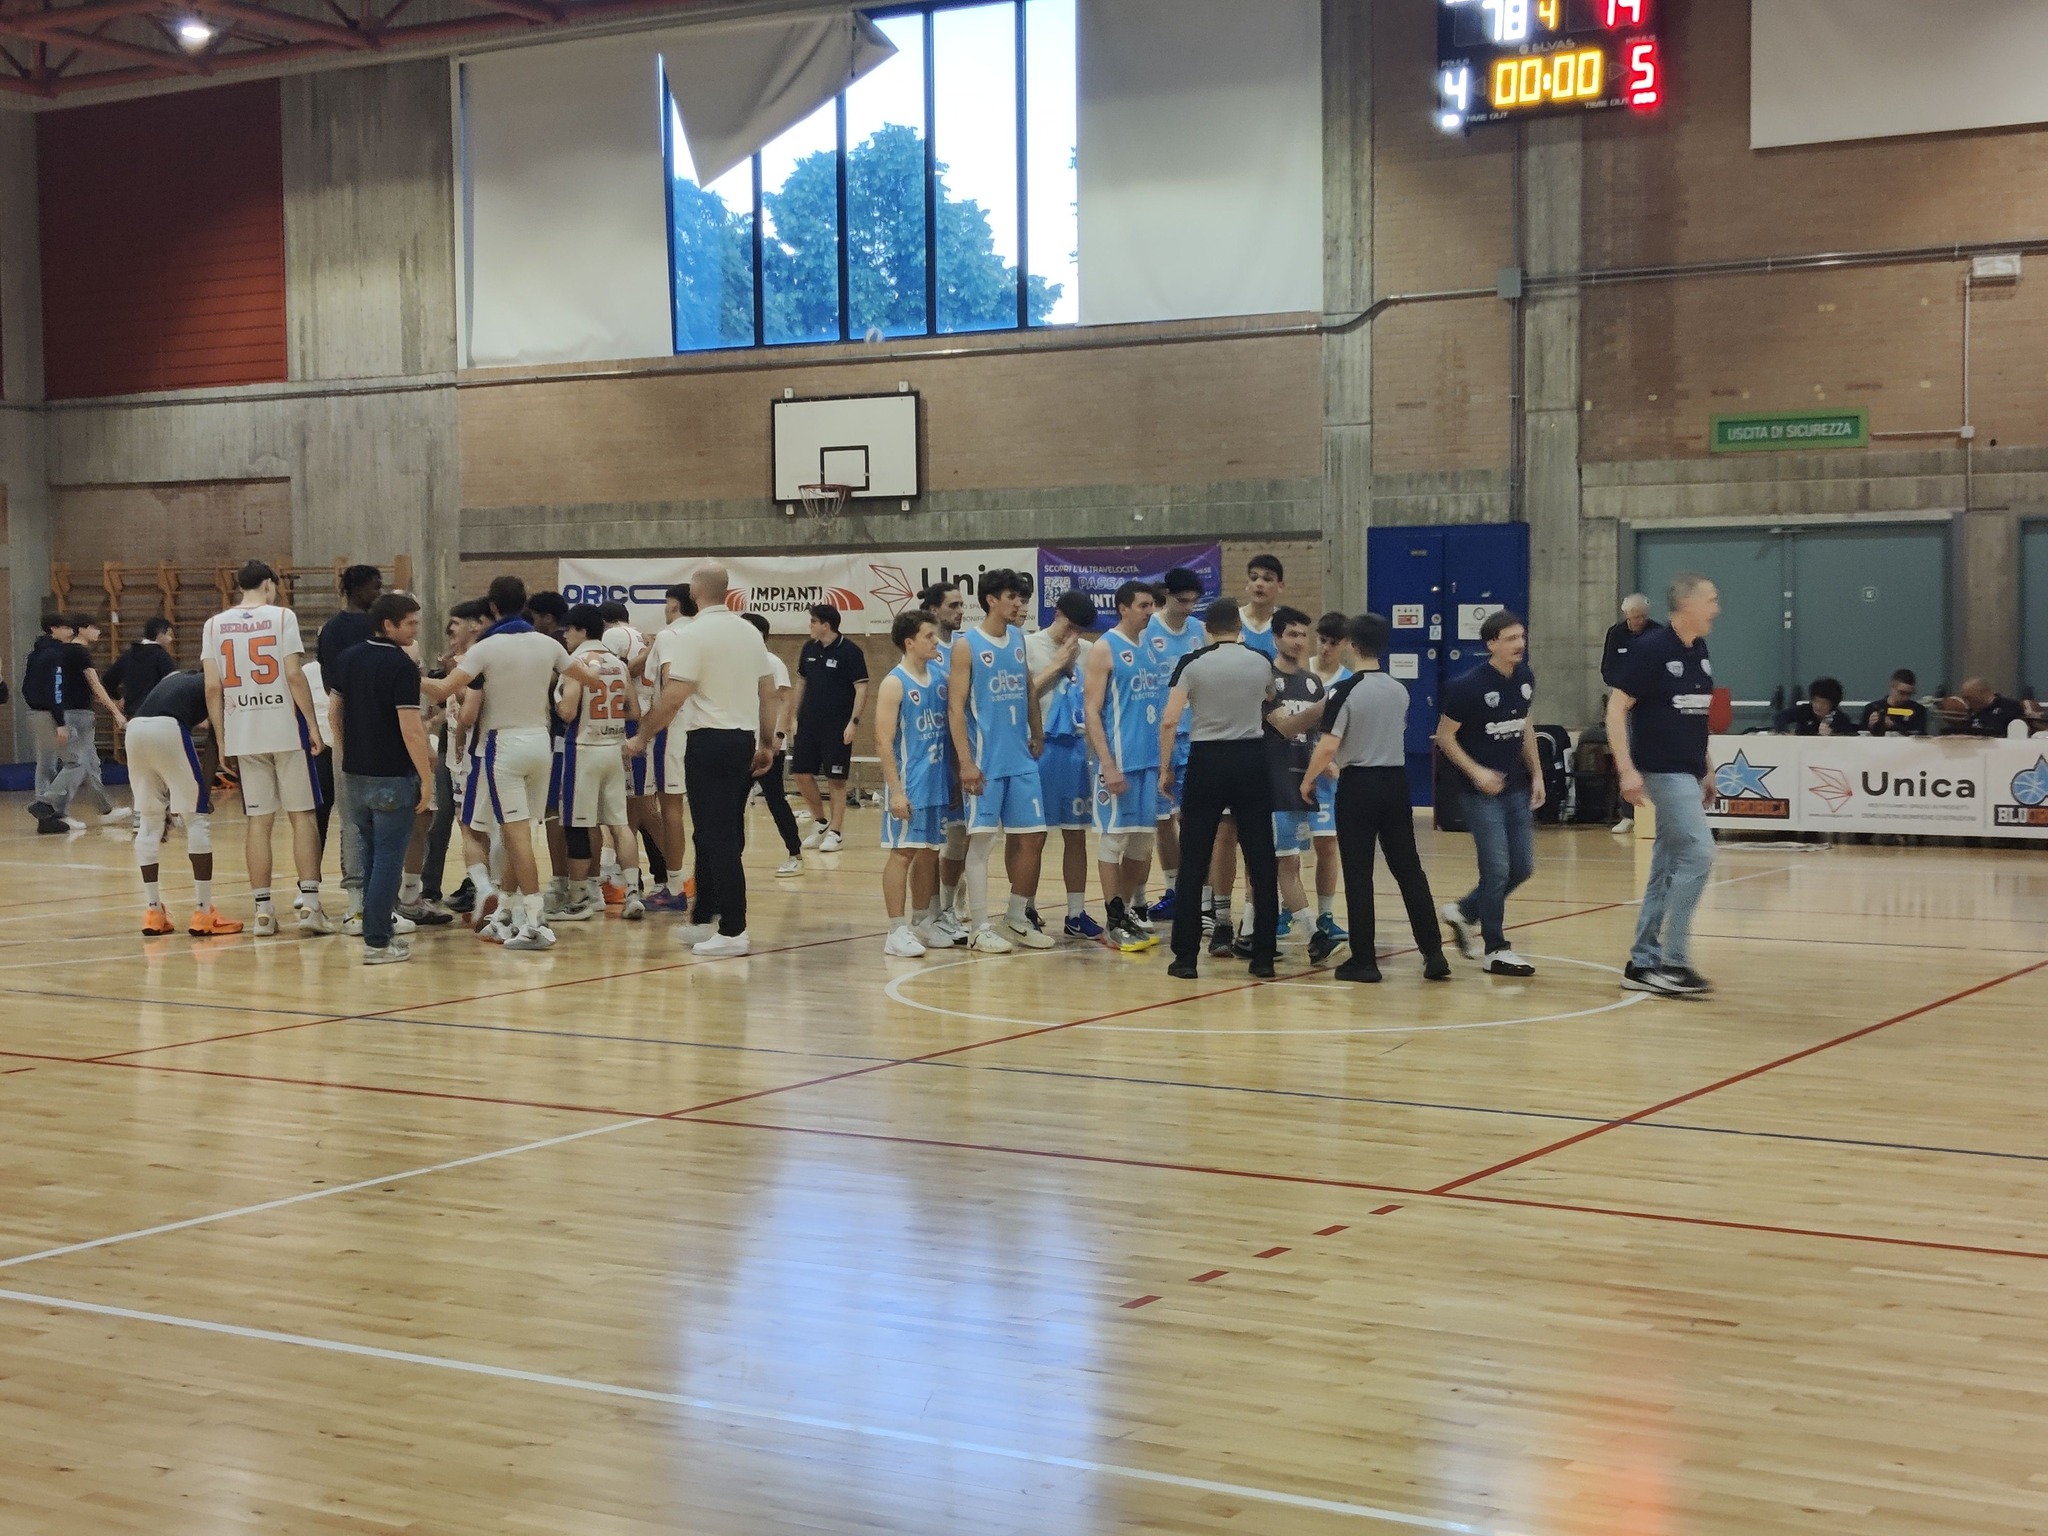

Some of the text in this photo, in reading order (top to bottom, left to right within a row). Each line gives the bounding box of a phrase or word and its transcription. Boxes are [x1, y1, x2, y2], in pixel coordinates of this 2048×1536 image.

[1630, 44, 1655, 90] 5
[1444, 67, 1468, 110] 4
[1494, 51, 1602, 106] 00:00
[1728, 423, 1852, 440] USCITA DI SICUREZZA
[1044, 565, 1072, 573] SCOPRI
[750, 586, 823, 601] IMPIANTI
[749, 601, 823, 612] INDUSTRIA
[220, 635, 280, 688] 15
[238, 692, 284, 707] Unica
[589, 680, 625, 719] 22
[1009, 705, 1017, 725] 1
[1146, 704, 1156, 724] 8
[1861, 771, 1976, 798] Unica
[1032, 798, 1041, 817] 1
[1317, 803, 1331, 822] 5
